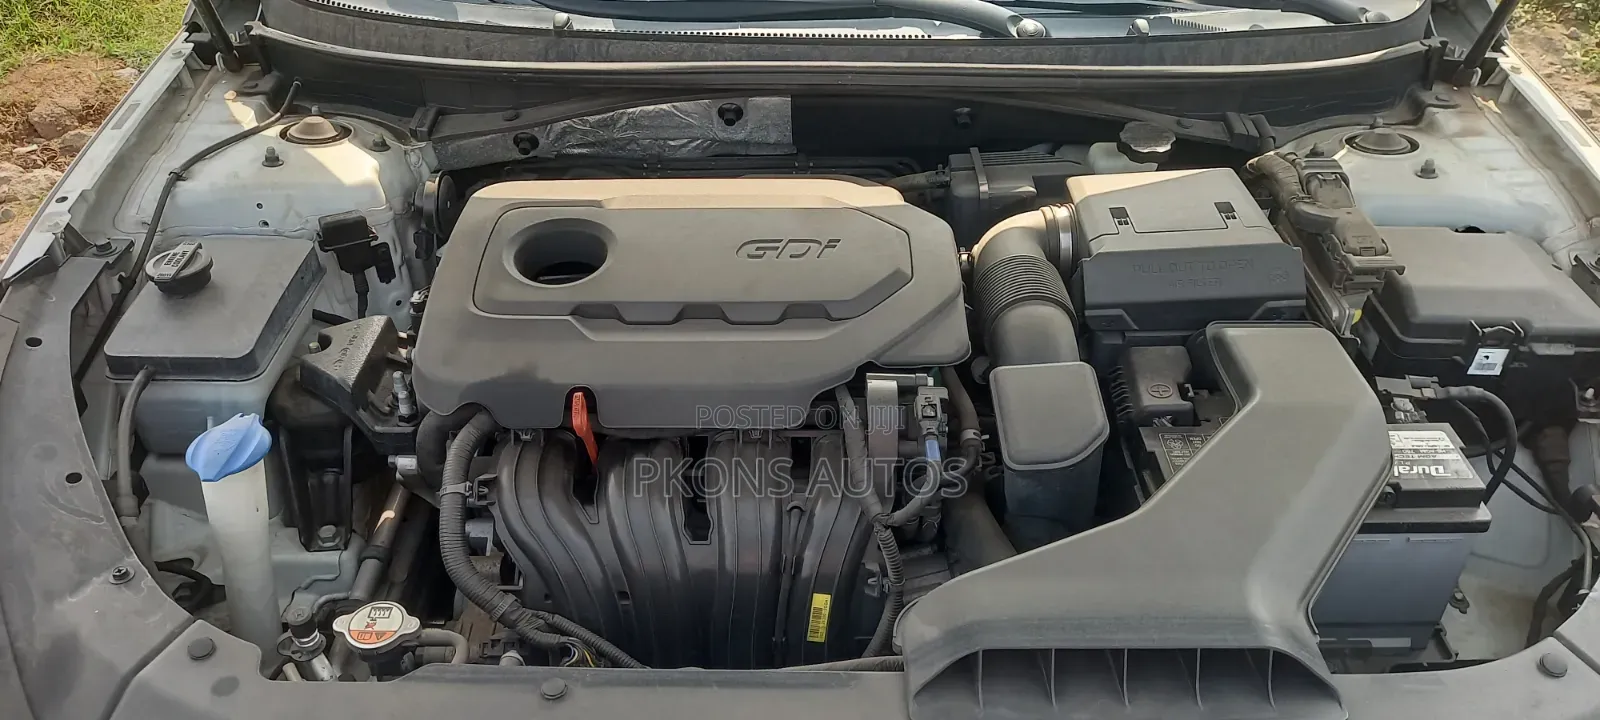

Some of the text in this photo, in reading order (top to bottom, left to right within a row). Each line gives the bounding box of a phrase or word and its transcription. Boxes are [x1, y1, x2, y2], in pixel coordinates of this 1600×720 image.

[1133, 261, 1164, 274] PULL
[1168, 260, 1194, 272] OUT
[1219, 257, 1255, 270] OPEN
